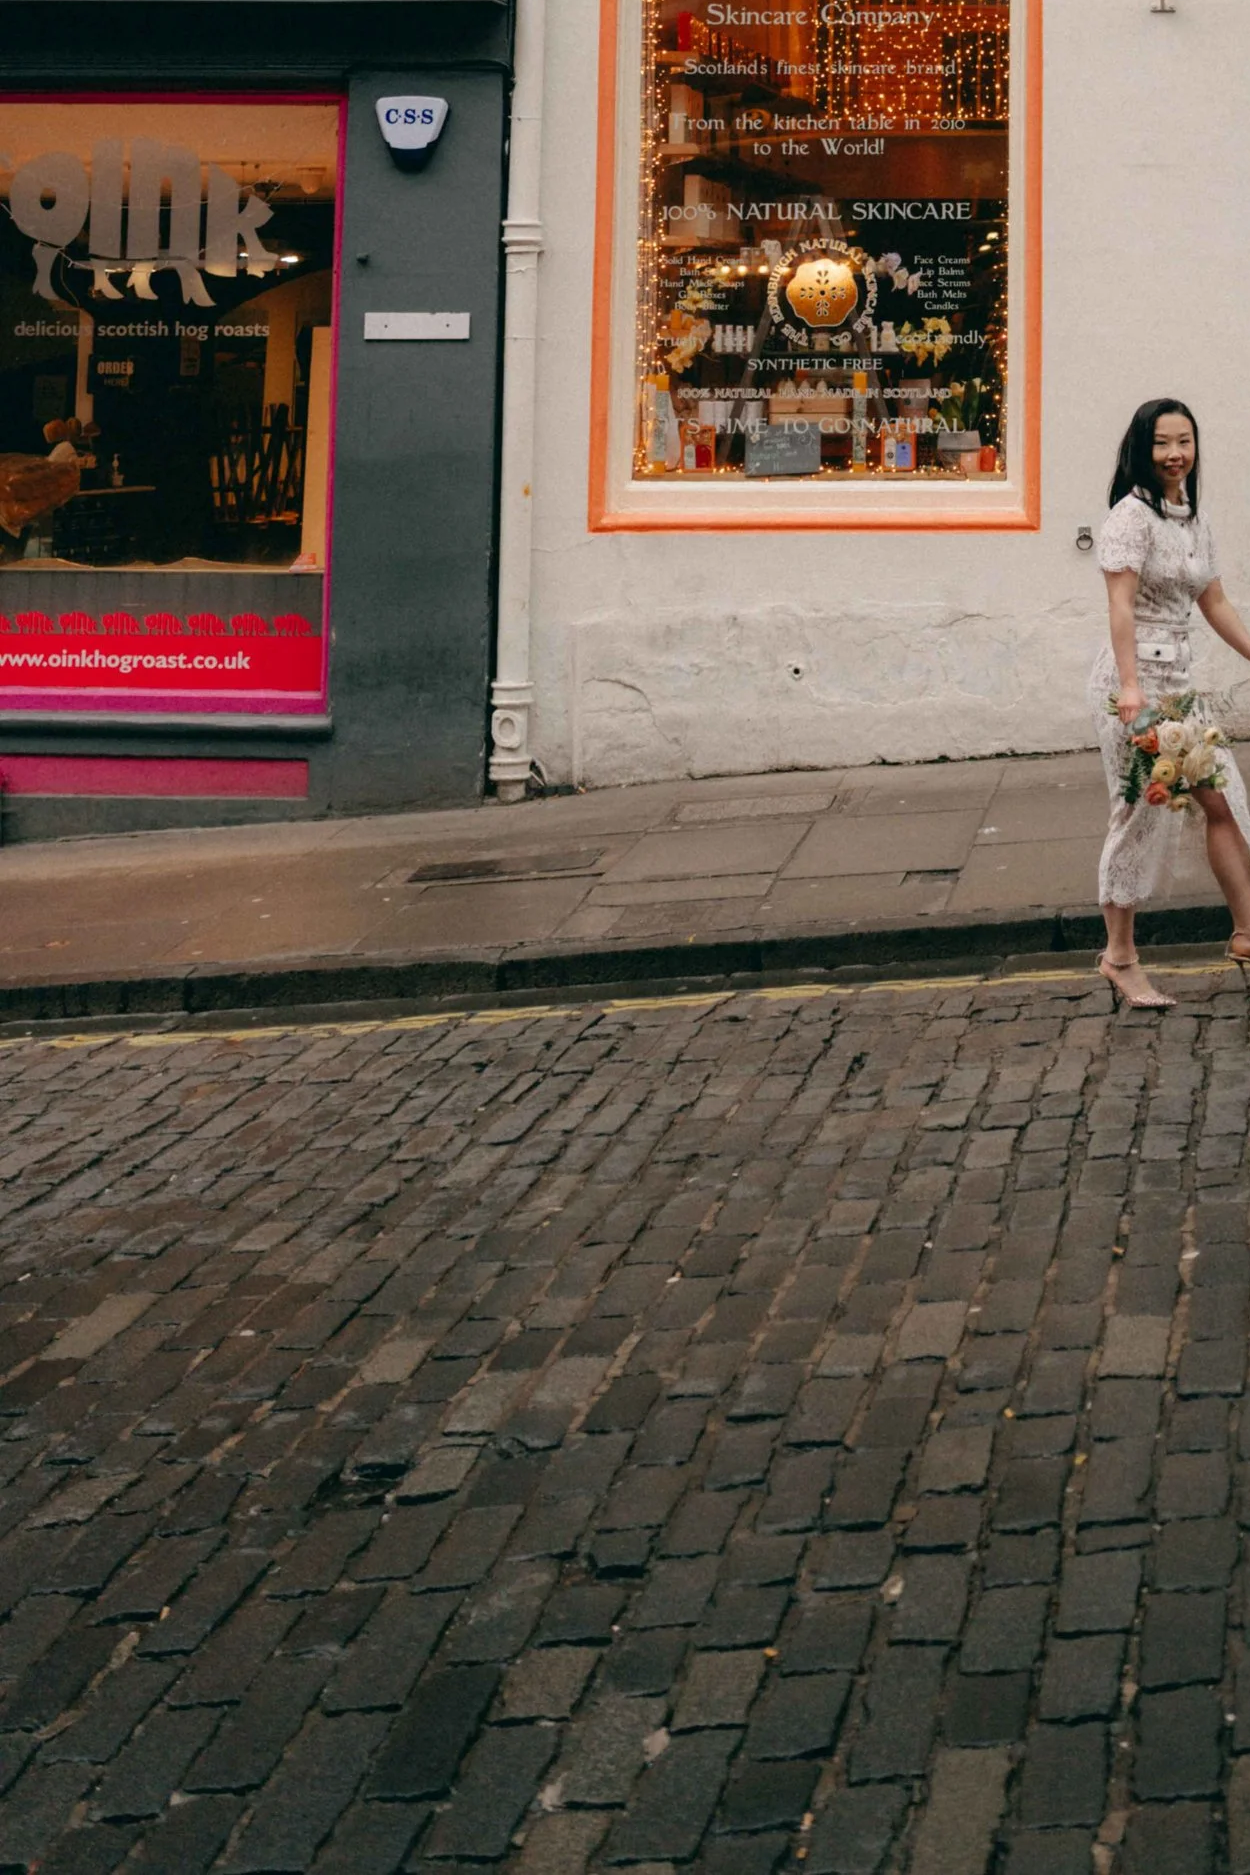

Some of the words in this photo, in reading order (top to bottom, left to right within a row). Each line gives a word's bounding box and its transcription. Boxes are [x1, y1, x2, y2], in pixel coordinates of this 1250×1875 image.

[706, 3, 808, 26] Skincare
[820, 3, 935, 32] Company
[777, 59, 821, 75] finest
[831, 58, 896, 75] skincare
[905, 59, 956, 75] brand
[672, 113, 725, 130] From
[735, 113, 762, 130] the
[773, 113, 841, 130] kitchen
[850, 113, 894, 130] table
[904, 113, 921, 130] in
[931, 119, 966, 130] 2010
[753, 141, 771, 156] to
[782, 138, 810, 156] the
[821, 138, 885, 156] World!
[662, 203, 717, 221] 100%
[727, 202, 842, 220] NATURAL
[852, 202, 972, 220] SKINCARE
[799, 238, 862, 265] NATURAL
[687, 256, 711, 265] Hand
[914, 256, 934, 265] Face
[938, 256, 971, 265] Creams
[679, 267, 700, 276] Bath
[920, 267, 933, 277] Lip
[939, 267, 965, 276] Balms
[660, 279, 684, 288] Hand
[767, 248, 799, 324] EDINBURGH
[937, 279, 971, 287] Serums
[917, 290, 938, 299] Bath
[942, 290, 967, 299] Melts
[924, 301, 959, 311] Candles
[14, 321, 92, 338] delicious
[97, 321, 169, 337] scottish
[175, 321, 209, 341] hog
[214, 322, 271, 337] roasts
[780, 324, 809, 347] THE
[97, 361, 134, 375] ORDER
[748, 358, 836, 370] SYNTHETIC
[842, 358, 884, 370] FREE
[678, 388, 711, 399] 100%
[714, 388, 775, 399] NATURAL
[883, 387, 952, 399] SCOTLAND
[713, 417, 768, 435] TIME
[779, 417, 809, 434] TO
[818, 417, 848, 435] GO
[853, 417, 966, 435] NATURAL
